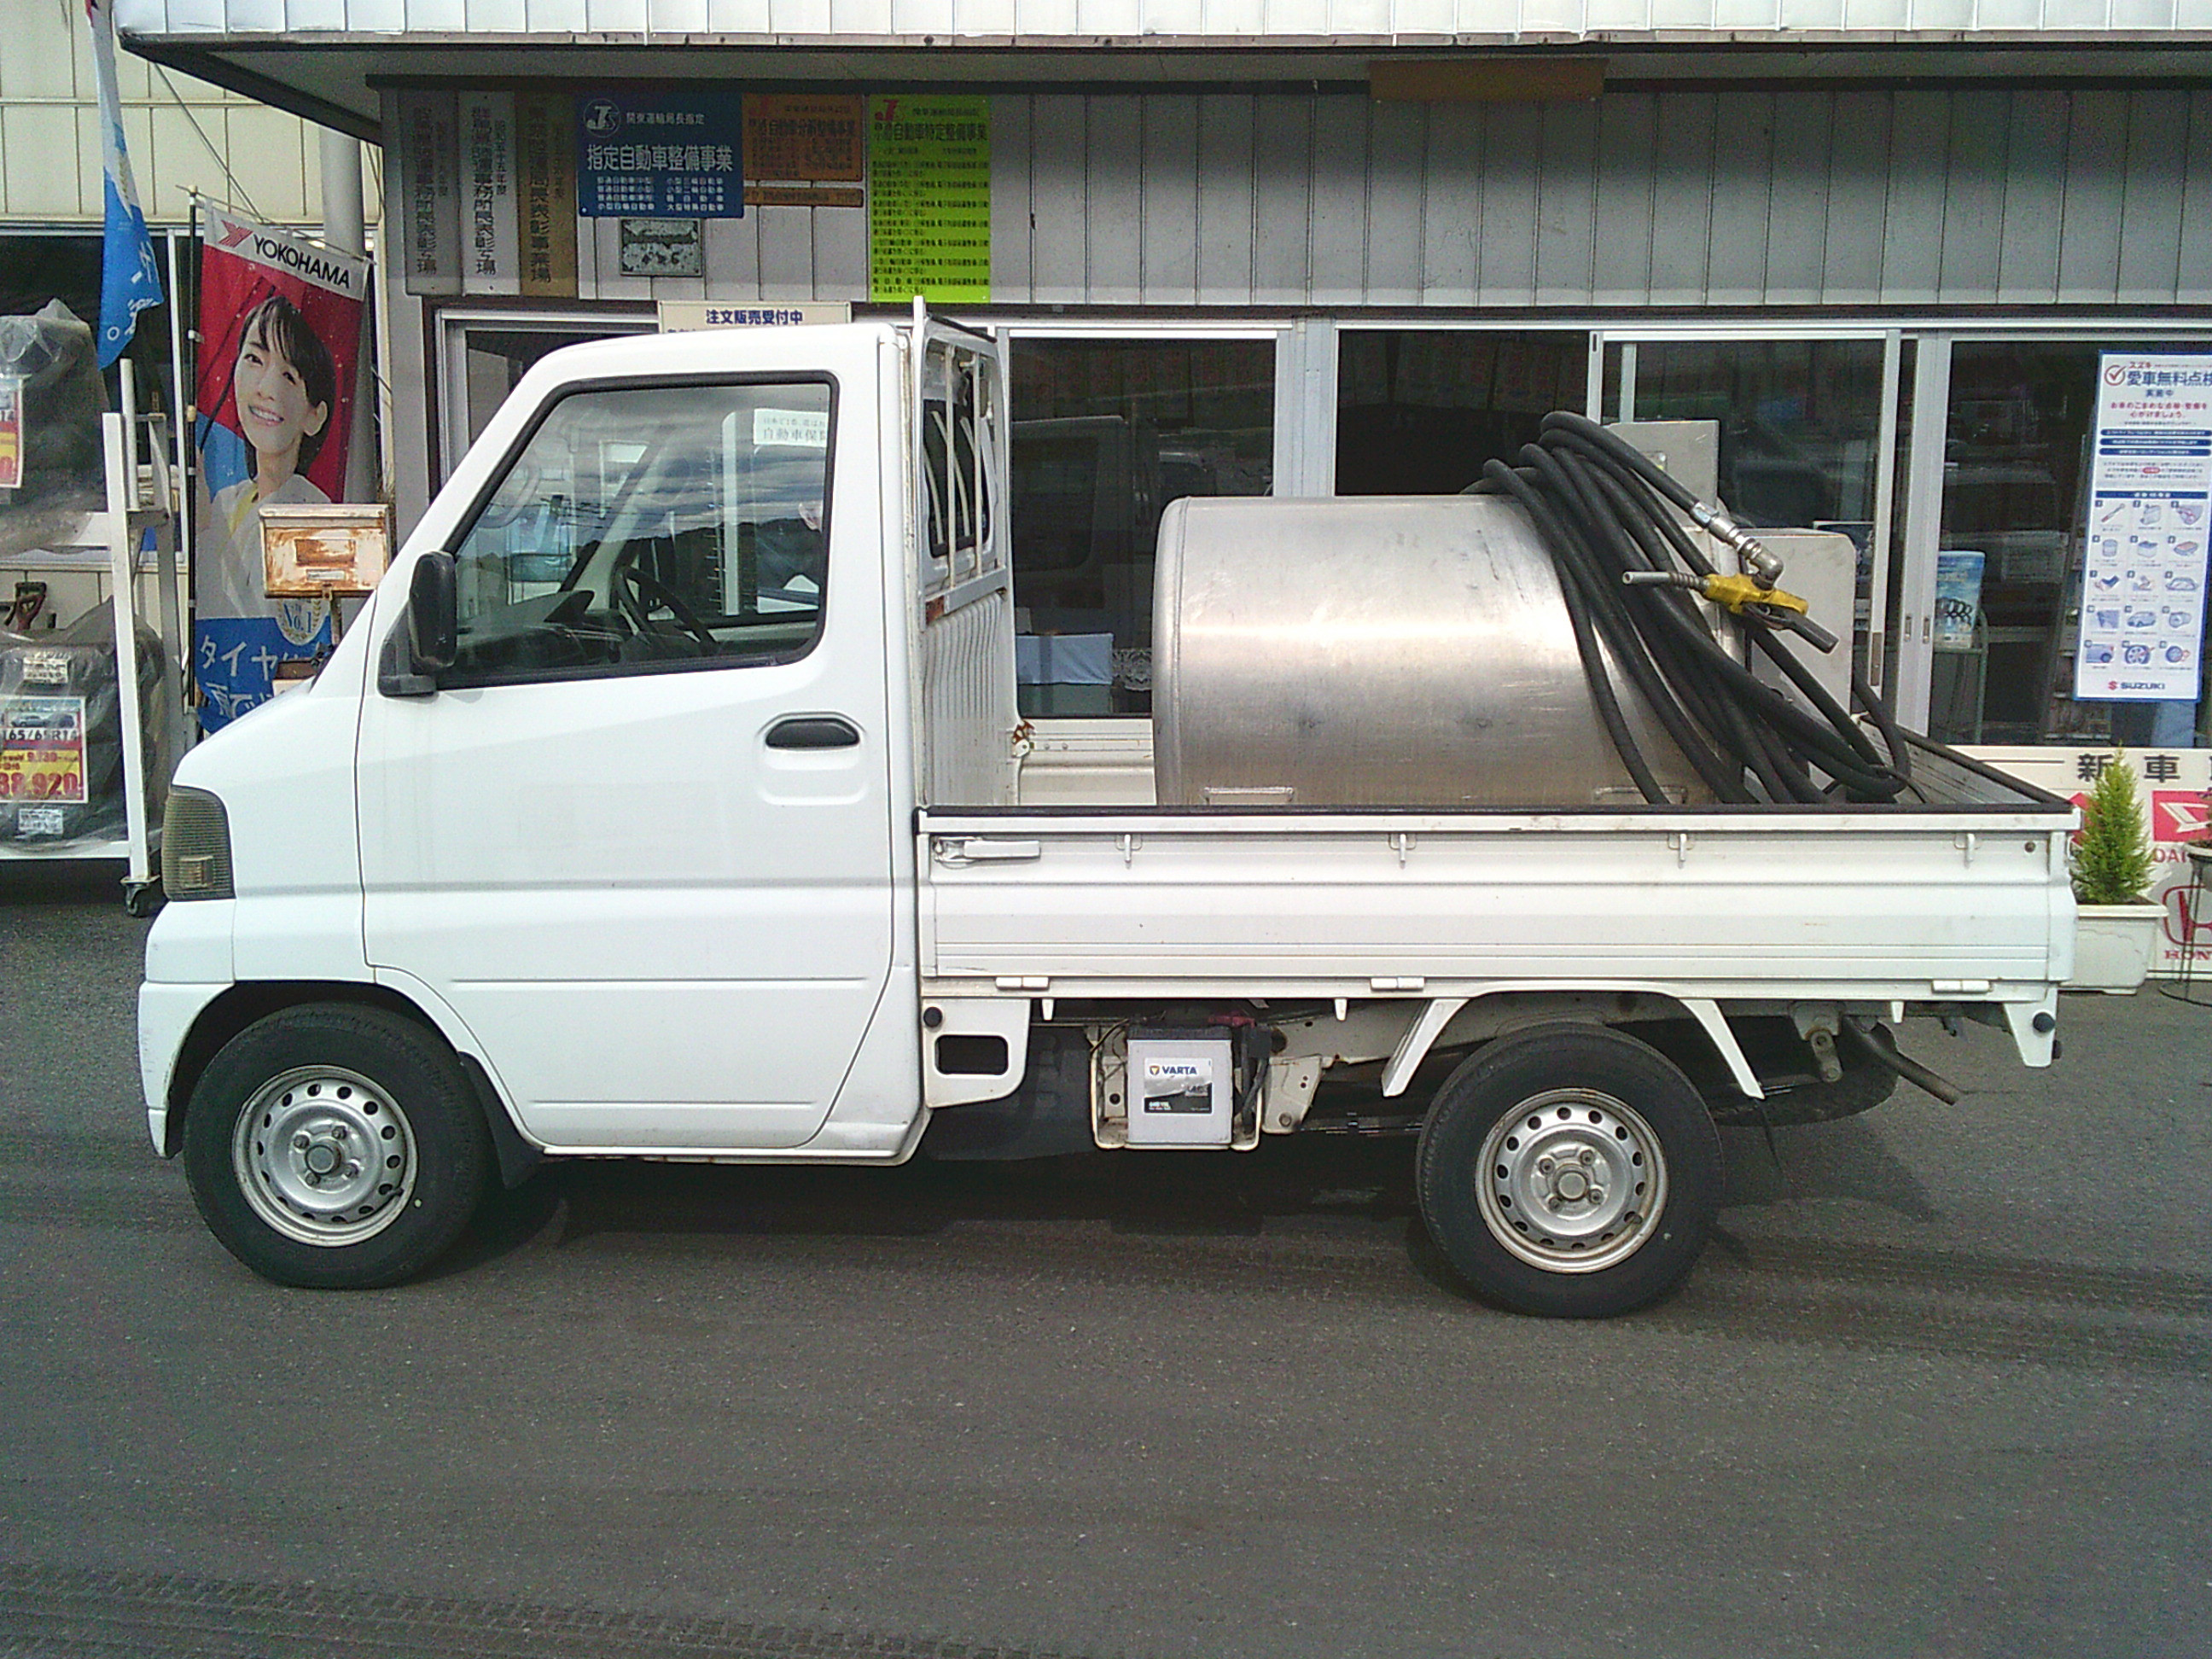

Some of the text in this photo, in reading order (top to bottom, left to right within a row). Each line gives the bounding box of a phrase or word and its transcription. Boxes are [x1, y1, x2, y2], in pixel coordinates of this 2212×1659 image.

[586, 144, 733, 172] 指定自動車整備事業
[253, 233, 351, 289] YOKOHAMA
[706, 309, 804, 325] 注文販売受付中
[201, 634, 300, 681] タイヤ
[2120, 681, 2166, 690] SUZUKI
[1162, 1066, 1197, 1075] VARTA
